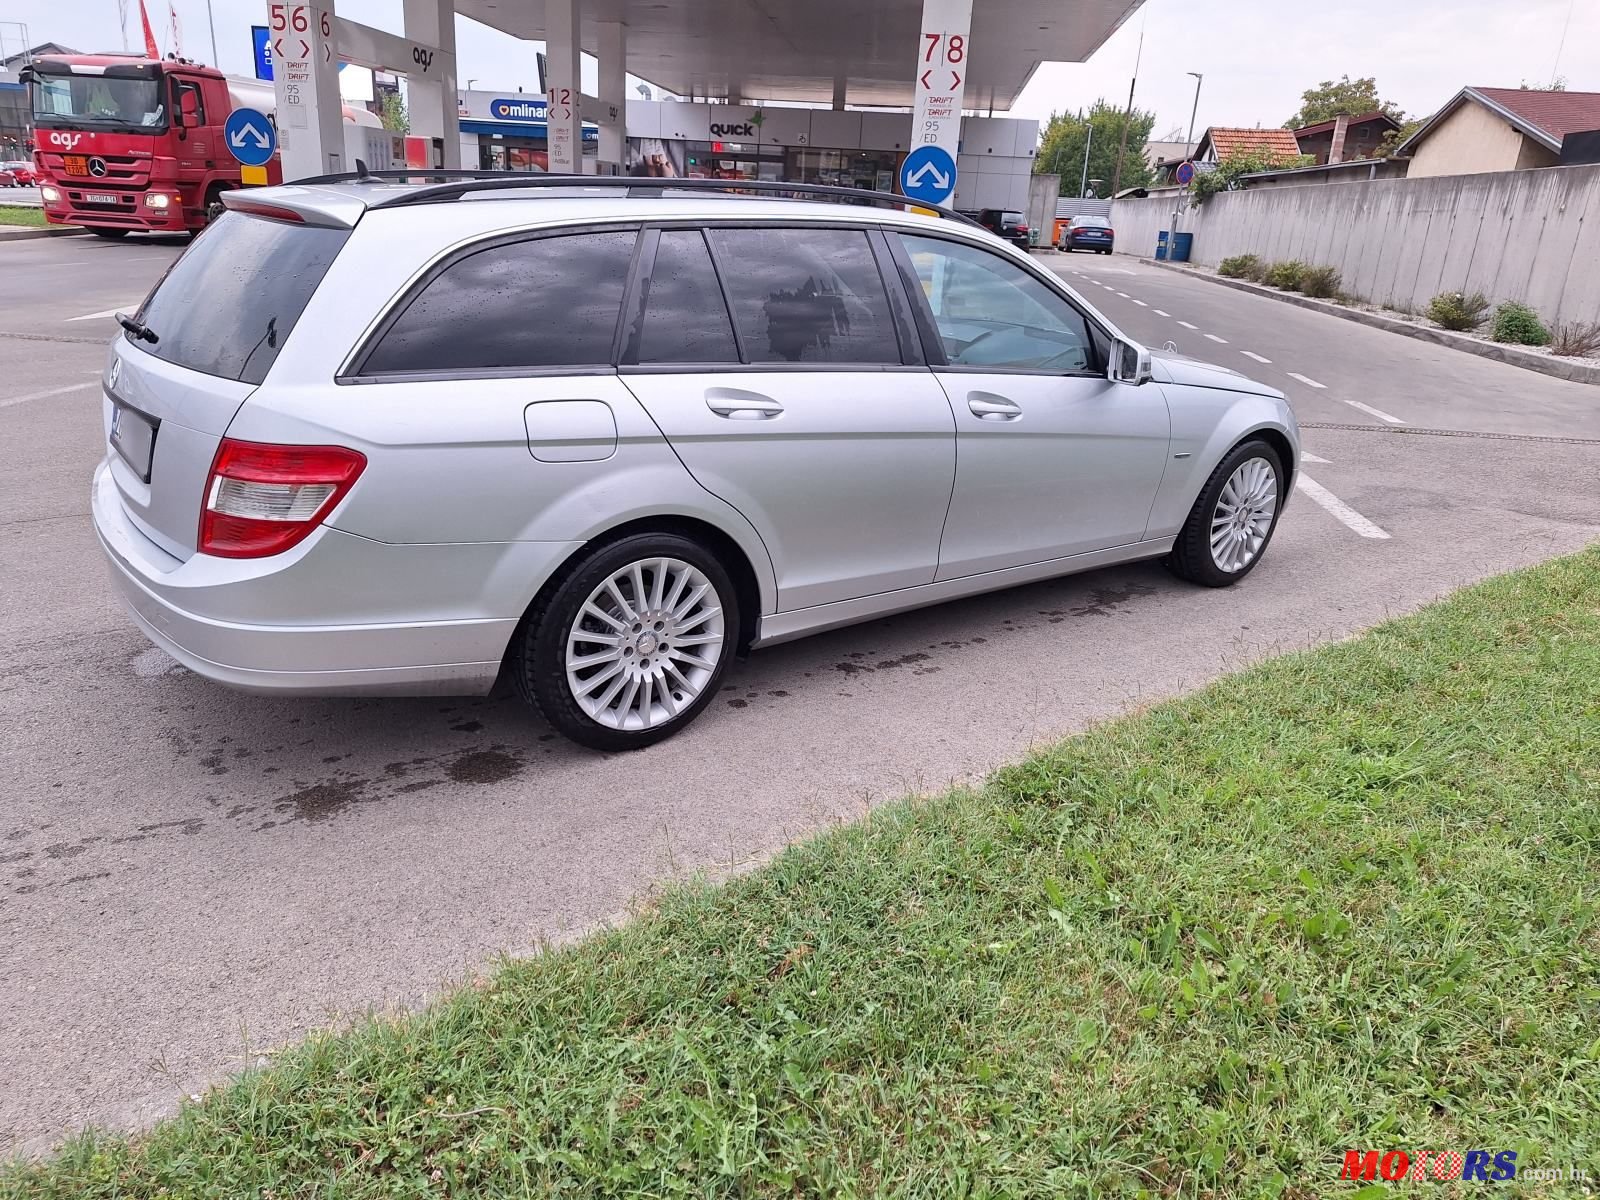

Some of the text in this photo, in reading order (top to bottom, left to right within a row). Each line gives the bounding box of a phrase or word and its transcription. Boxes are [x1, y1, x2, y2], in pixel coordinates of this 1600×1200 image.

[271, 4, 308, 33] 5 6
[321, 12, 330, 38] 6
[412, 45, 434, 73] ags
[925, 33, 964, 63] 7 8
[548, 88, 571, 105] 1 2
[50, 132, 82, 151] ags
